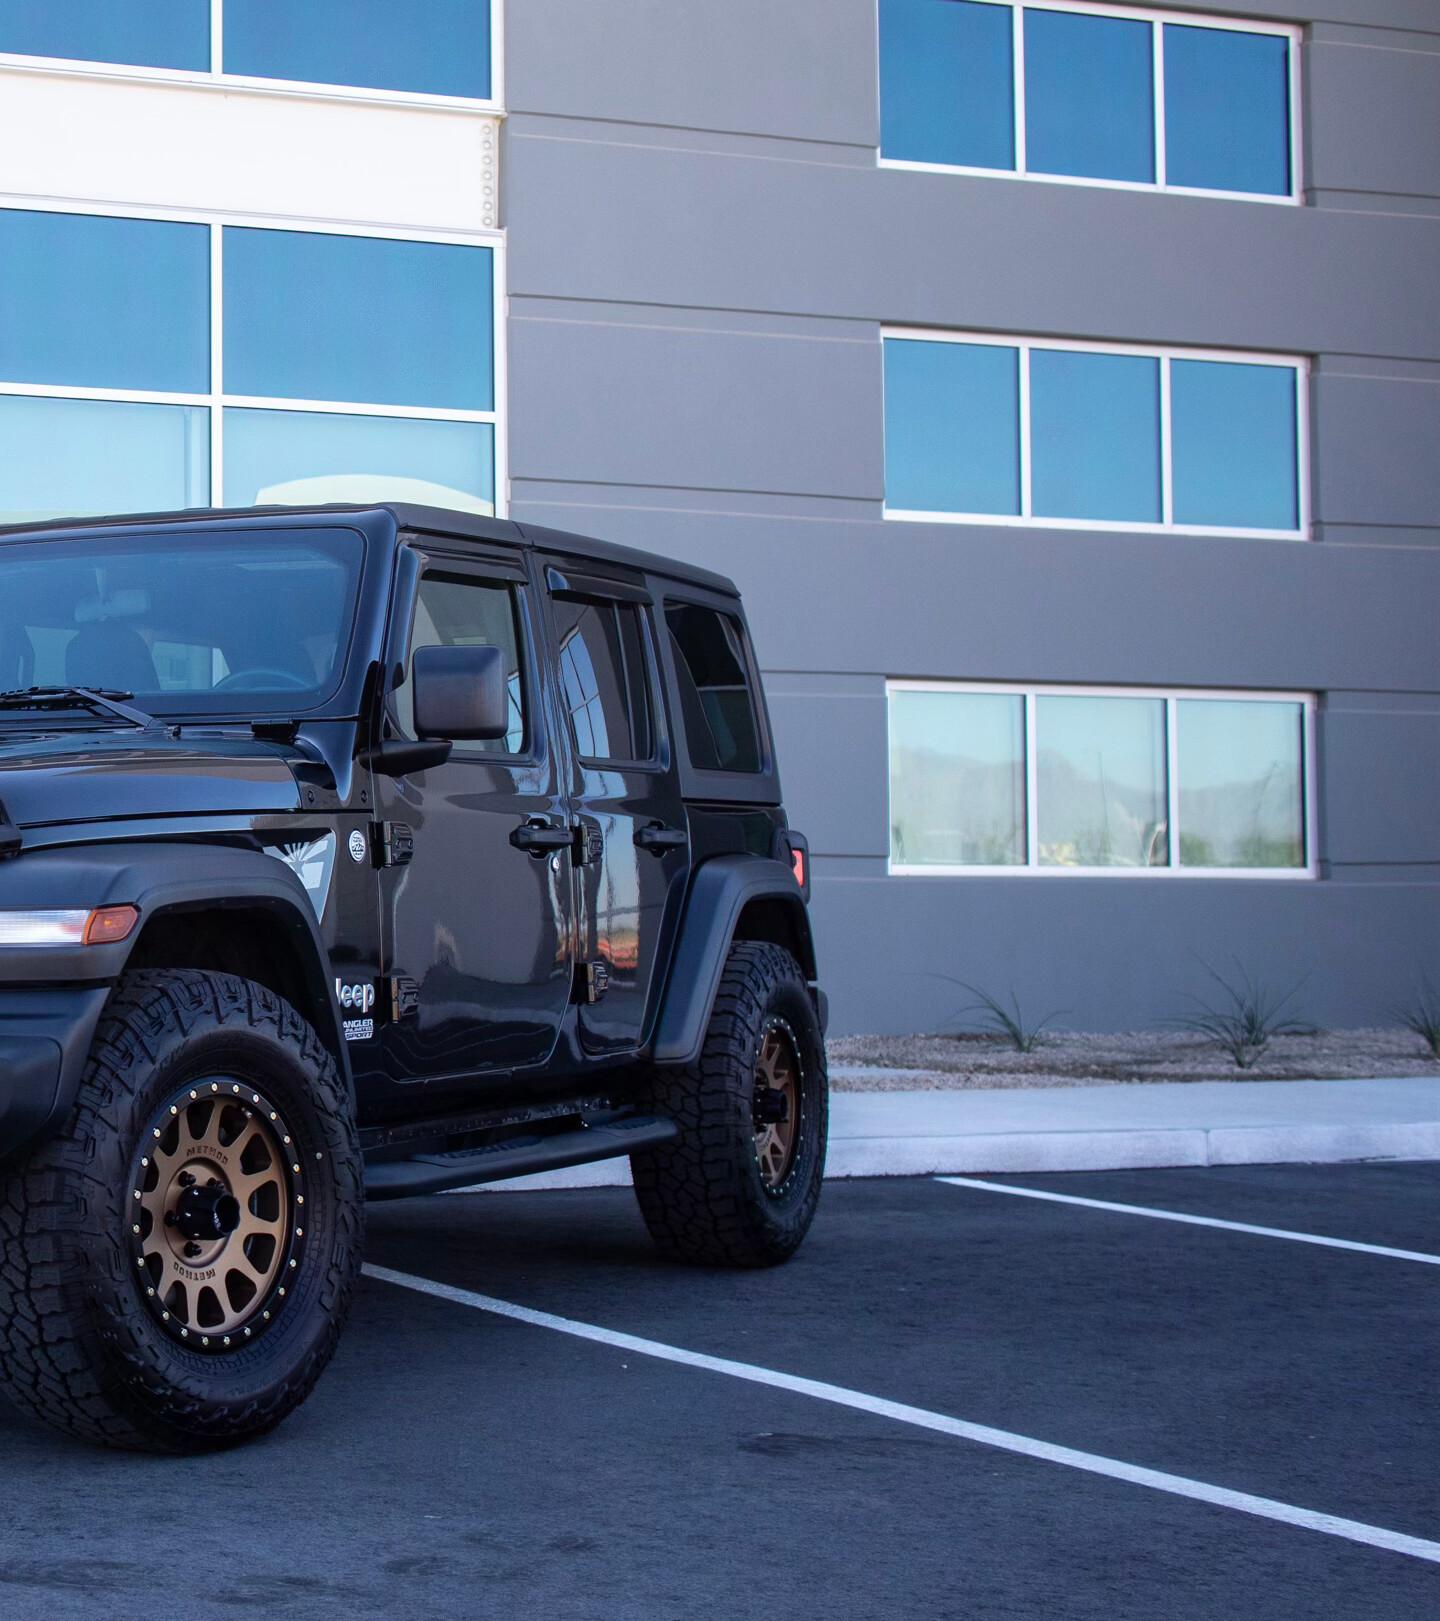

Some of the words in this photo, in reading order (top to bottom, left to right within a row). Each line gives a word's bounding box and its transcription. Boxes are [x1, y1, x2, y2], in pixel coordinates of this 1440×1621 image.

[336, 978, 375, 1013] Jeep
[186, 1145, 229, 1165] METHOD
[173, 1261, 216, 1281] METHOD
